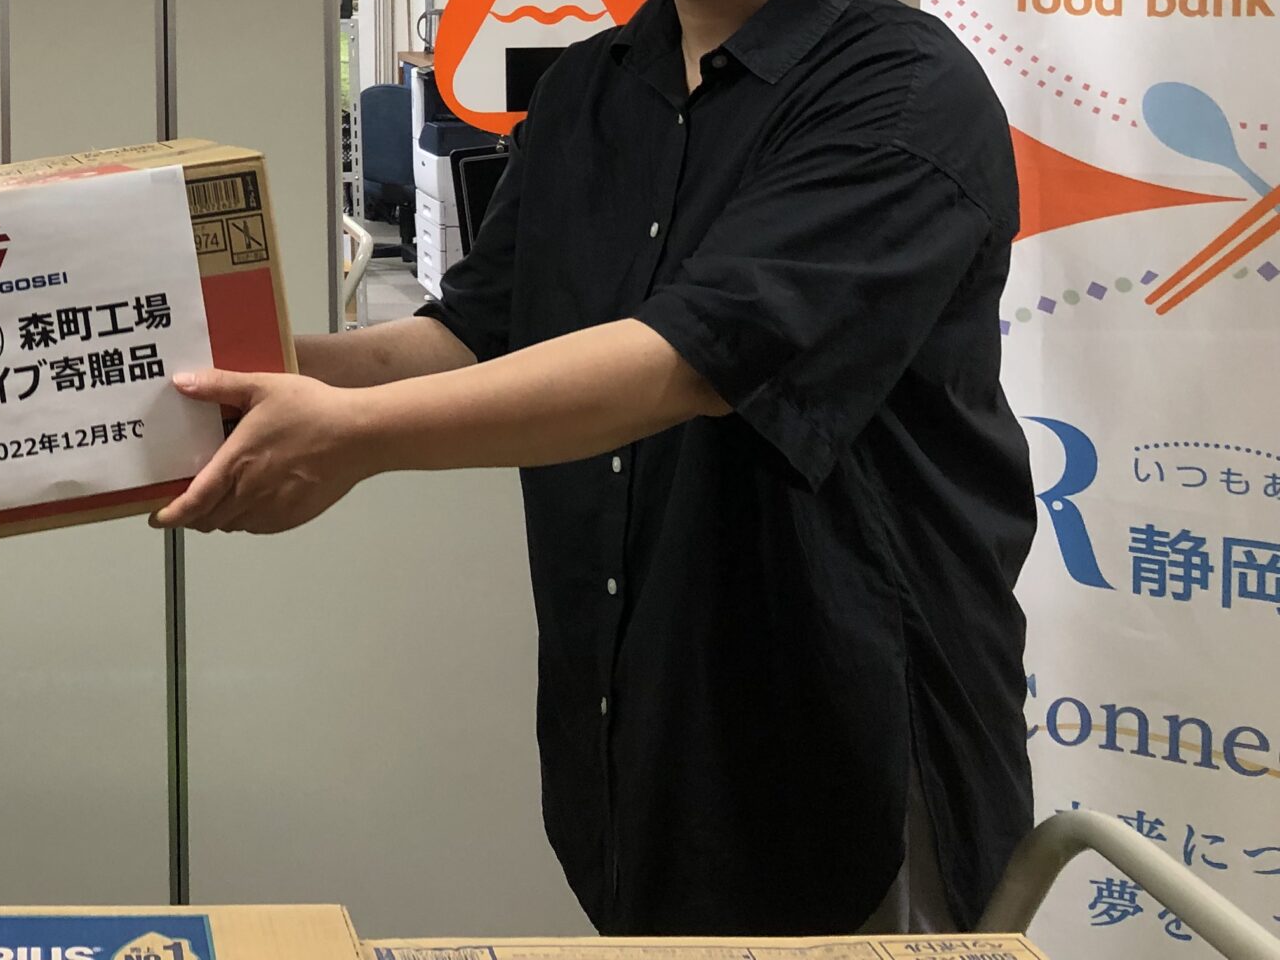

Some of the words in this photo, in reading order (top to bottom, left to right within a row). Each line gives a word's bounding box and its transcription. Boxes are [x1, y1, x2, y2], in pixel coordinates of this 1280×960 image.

[18, 292, 172, 352] 森町工場
[1026, 674, 1280, 777] onne
